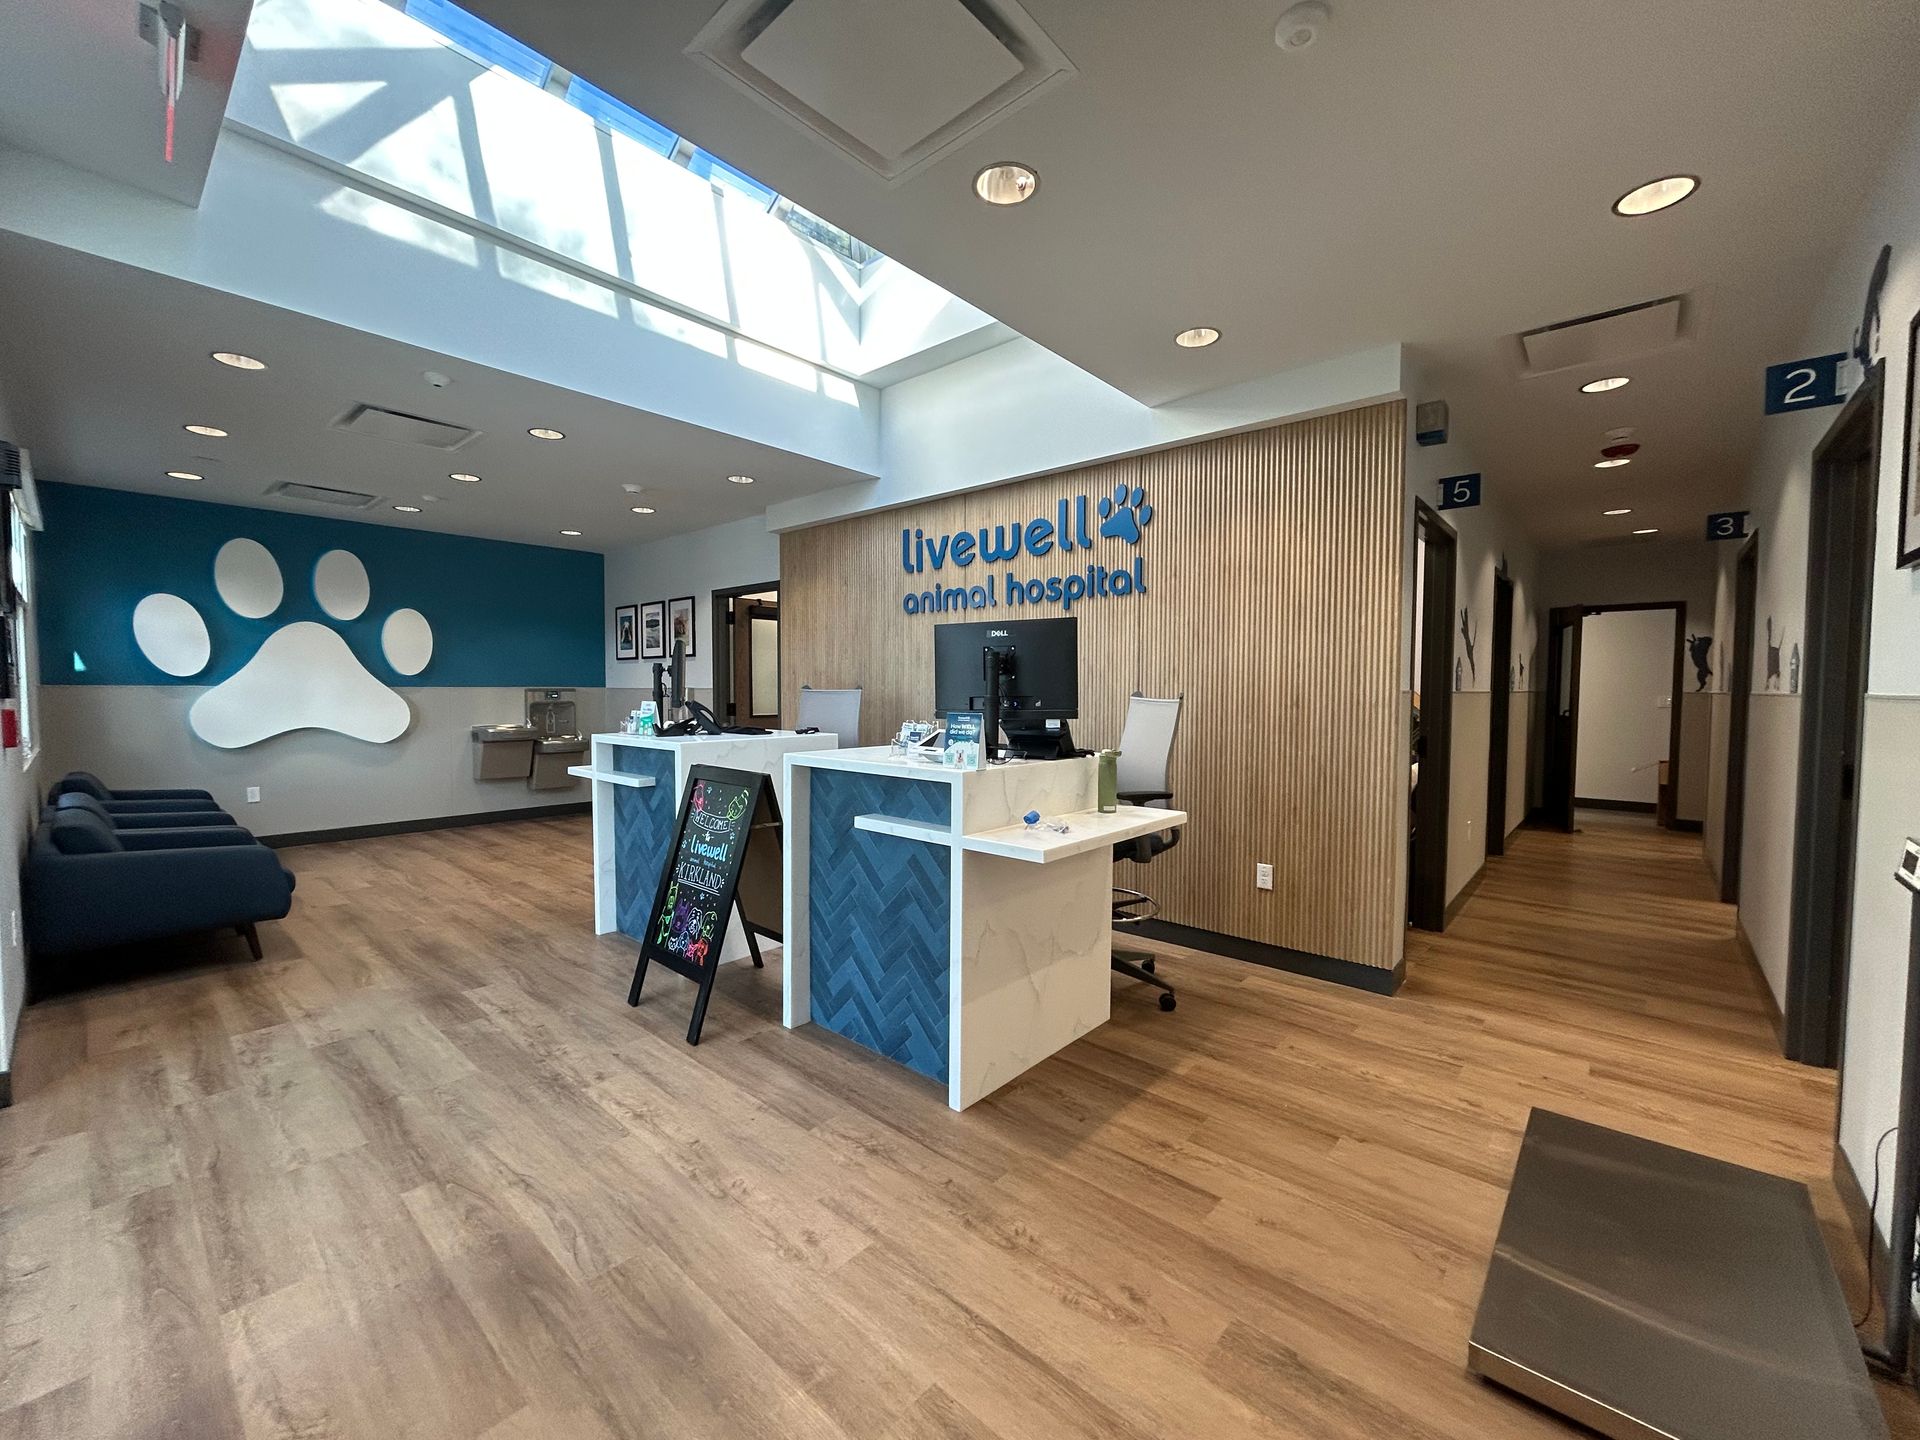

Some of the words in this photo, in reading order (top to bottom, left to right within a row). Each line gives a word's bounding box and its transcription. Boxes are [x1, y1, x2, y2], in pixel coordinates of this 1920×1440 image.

[1784, 368, 1816, 404] 2
[1453, 480, 1470, 502] 5
[902, 495, 1092, 573] livewell
[1716, 517, 1734, 536] 3
[903, 574, 996, 615] animal
[1006, 556, 1146, 610] hospital
[694, 811, 729, 831] WELCOME
[677, 861, 722, 890] KIRKLAND
